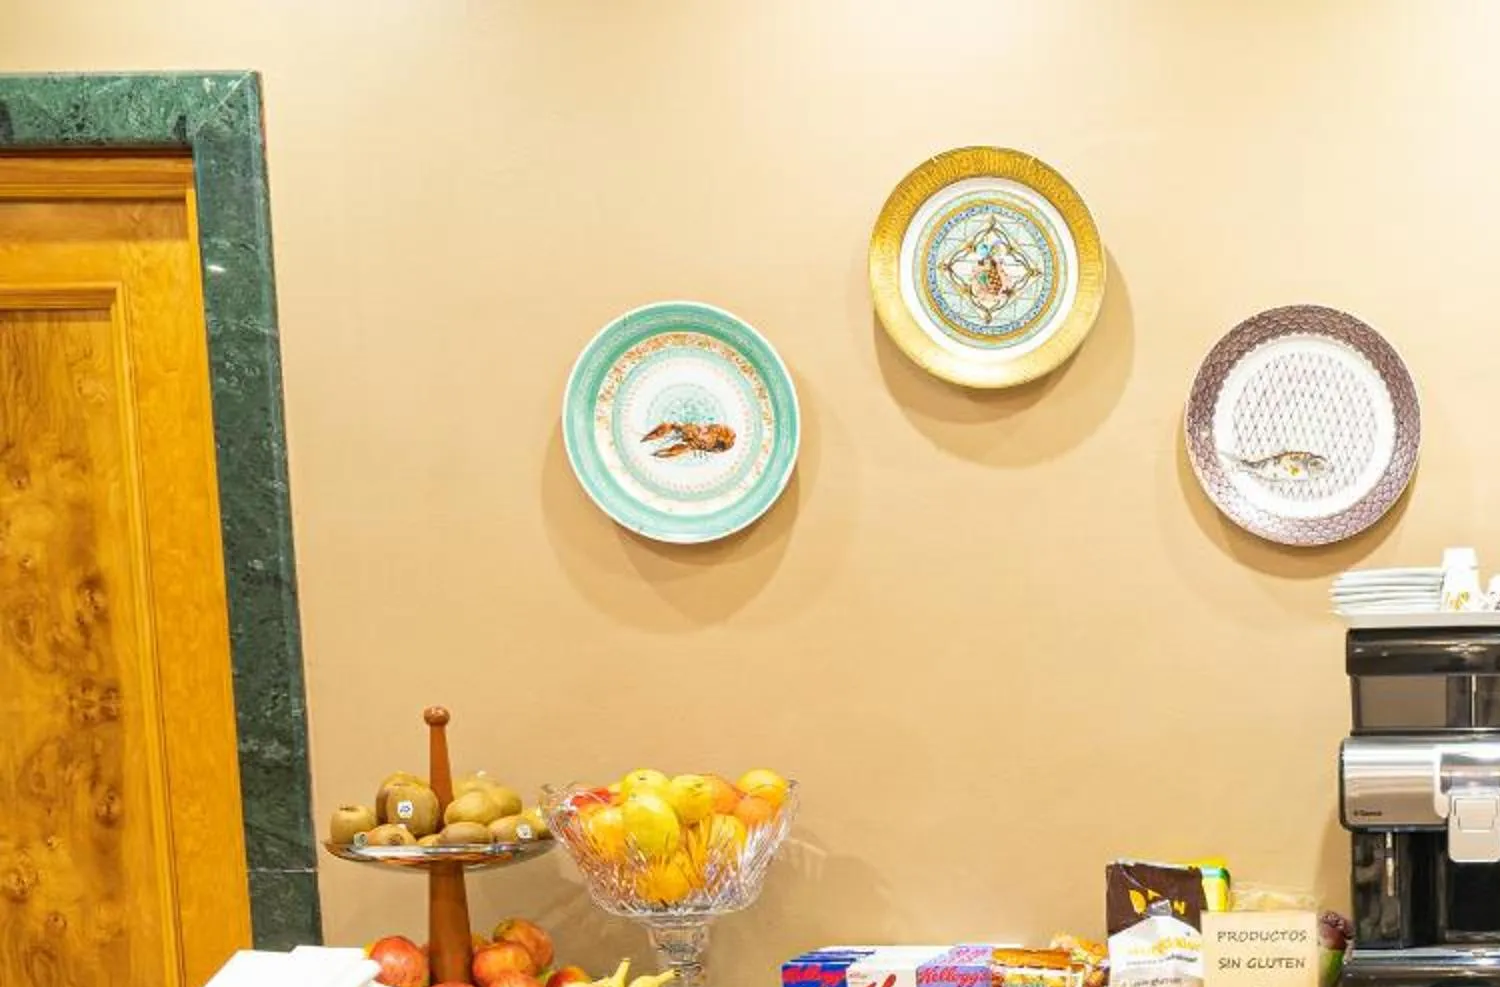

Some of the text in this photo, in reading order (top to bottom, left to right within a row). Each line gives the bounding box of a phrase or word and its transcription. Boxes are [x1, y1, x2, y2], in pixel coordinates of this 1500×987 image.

[1217, 930, 1307, 943] PRODUCTOS
[1218, 957, 1306, 970] SIN GLUTEN
